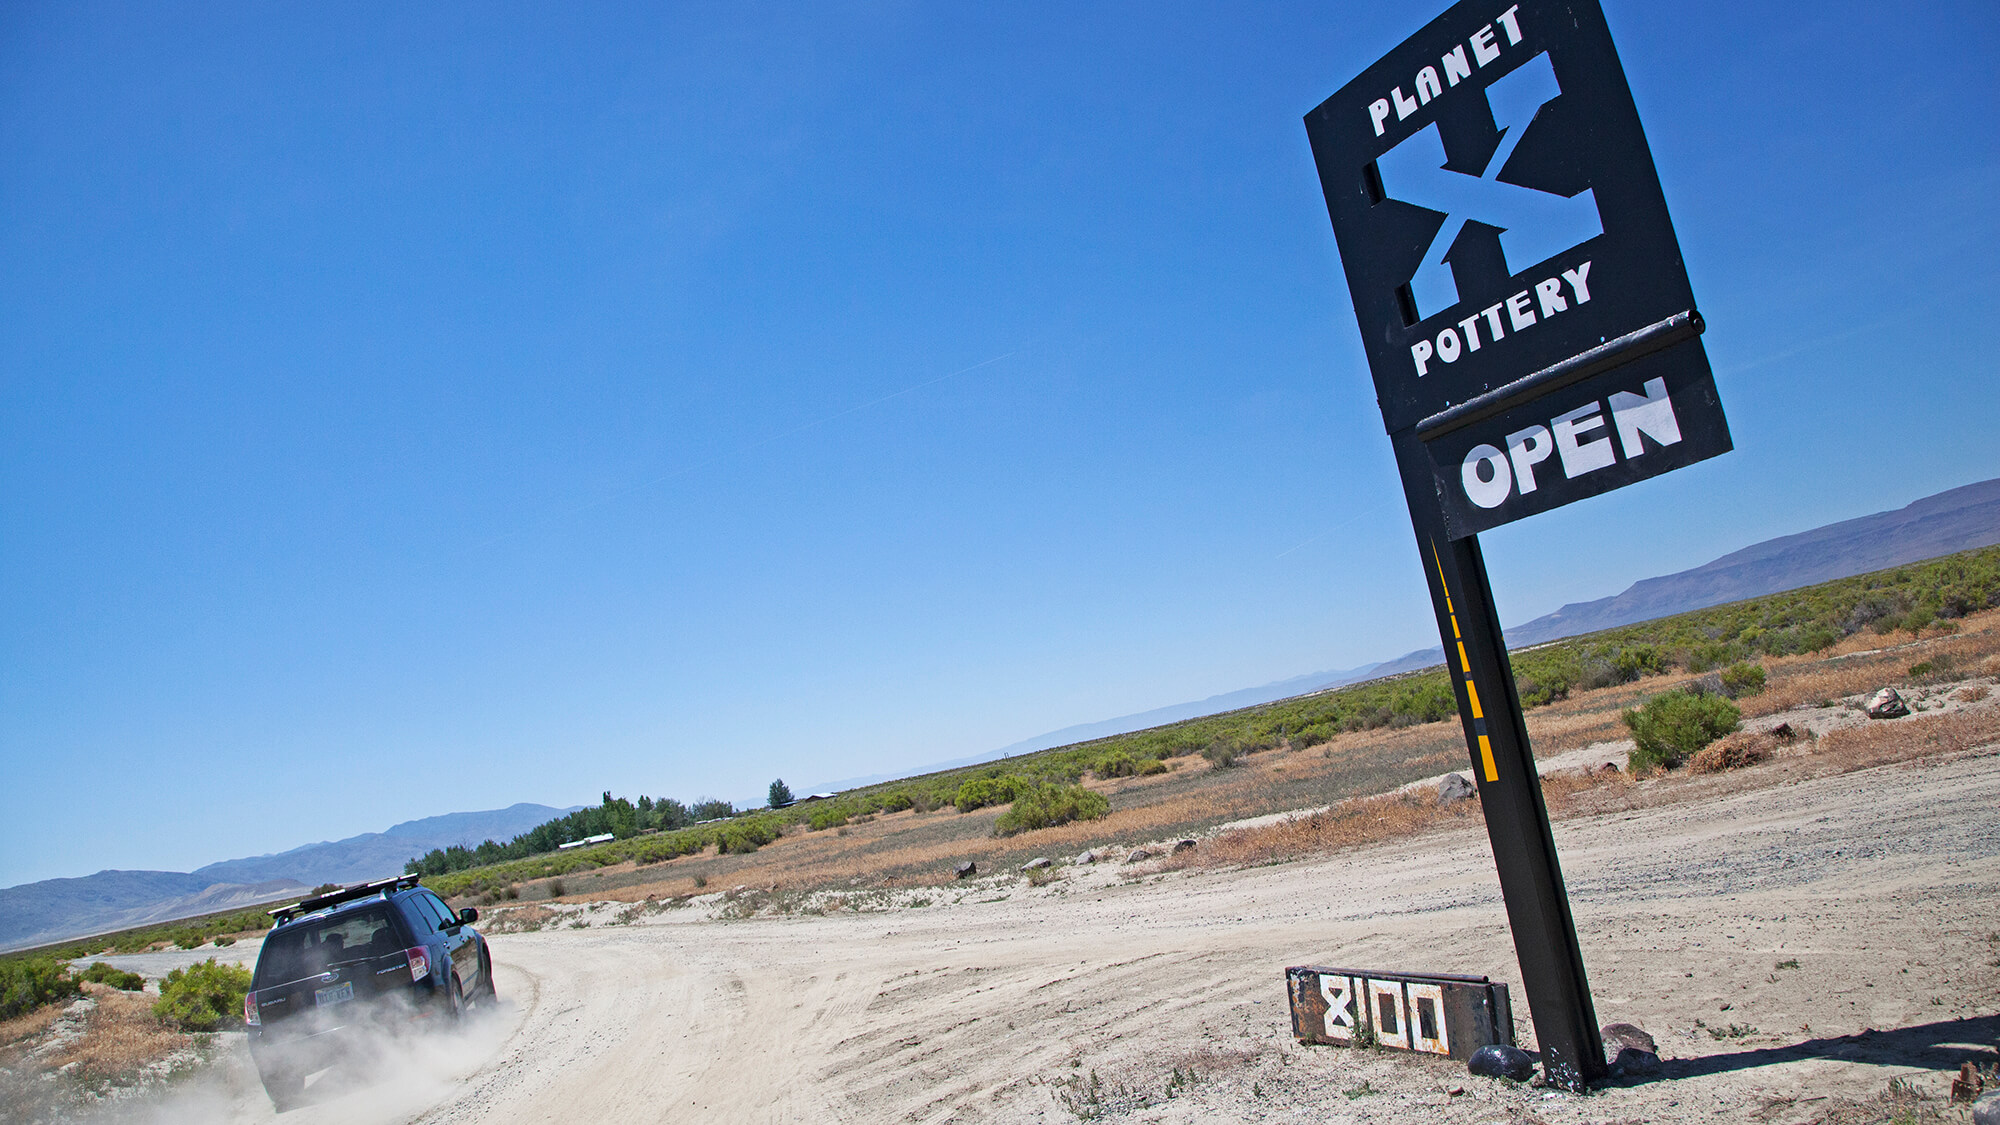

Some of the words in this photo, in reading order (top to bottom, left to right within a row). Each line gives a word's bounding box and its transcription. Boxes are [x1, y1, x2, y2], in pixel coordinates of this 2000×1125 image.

[1368, 4, 1523, 137] PLANET
[1411, 261, 1591, 377] POTTERY
[1461, 376, 1682, 509] OPEN
[1319, 974, 1450, 1055] 8100
